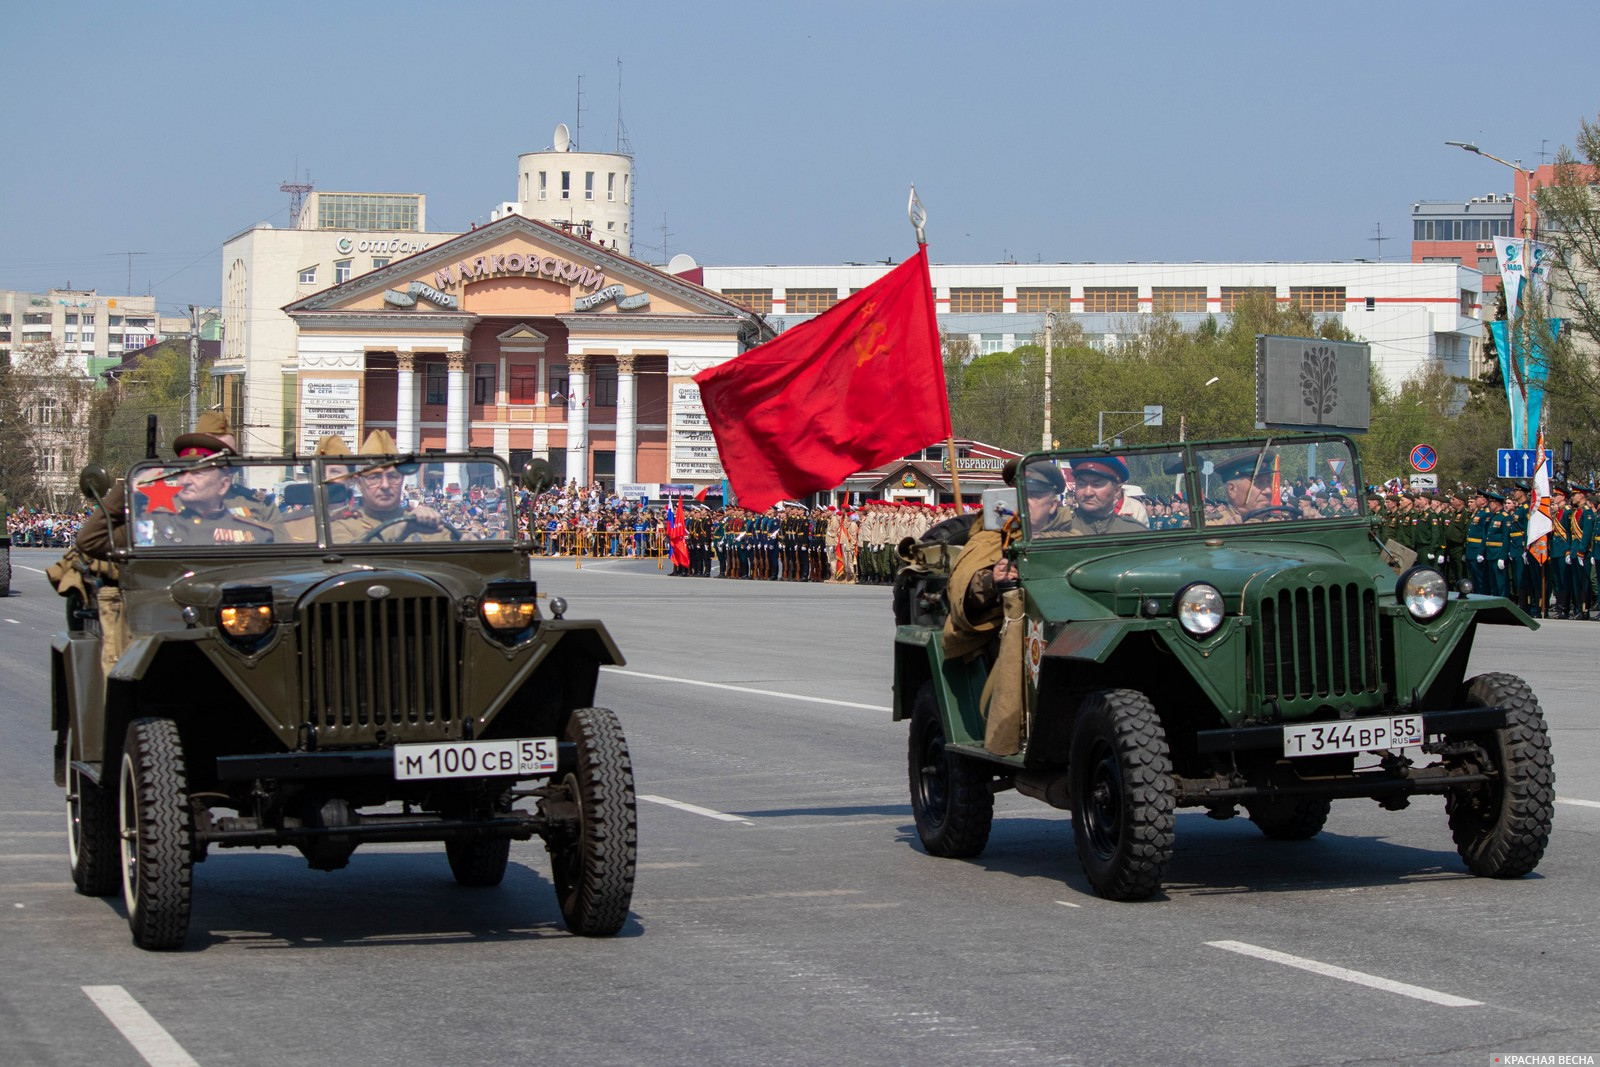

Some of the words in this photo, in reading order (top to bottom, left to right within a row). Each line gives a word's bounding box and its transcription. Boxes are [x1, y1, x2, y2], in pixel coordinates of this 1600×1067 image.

[434, 253, 606, 290] МАЯКОВСКИЙ
[419, 285, 450, 304] КИНО
[582, 285, 617, 306] ТЕАТР
[1393, 718, 1416, 737] 55
[1392, 737, 1409, 745] RUS
[522, 742, 547, 762] 55
[520, 762, 540, 771] RUS
